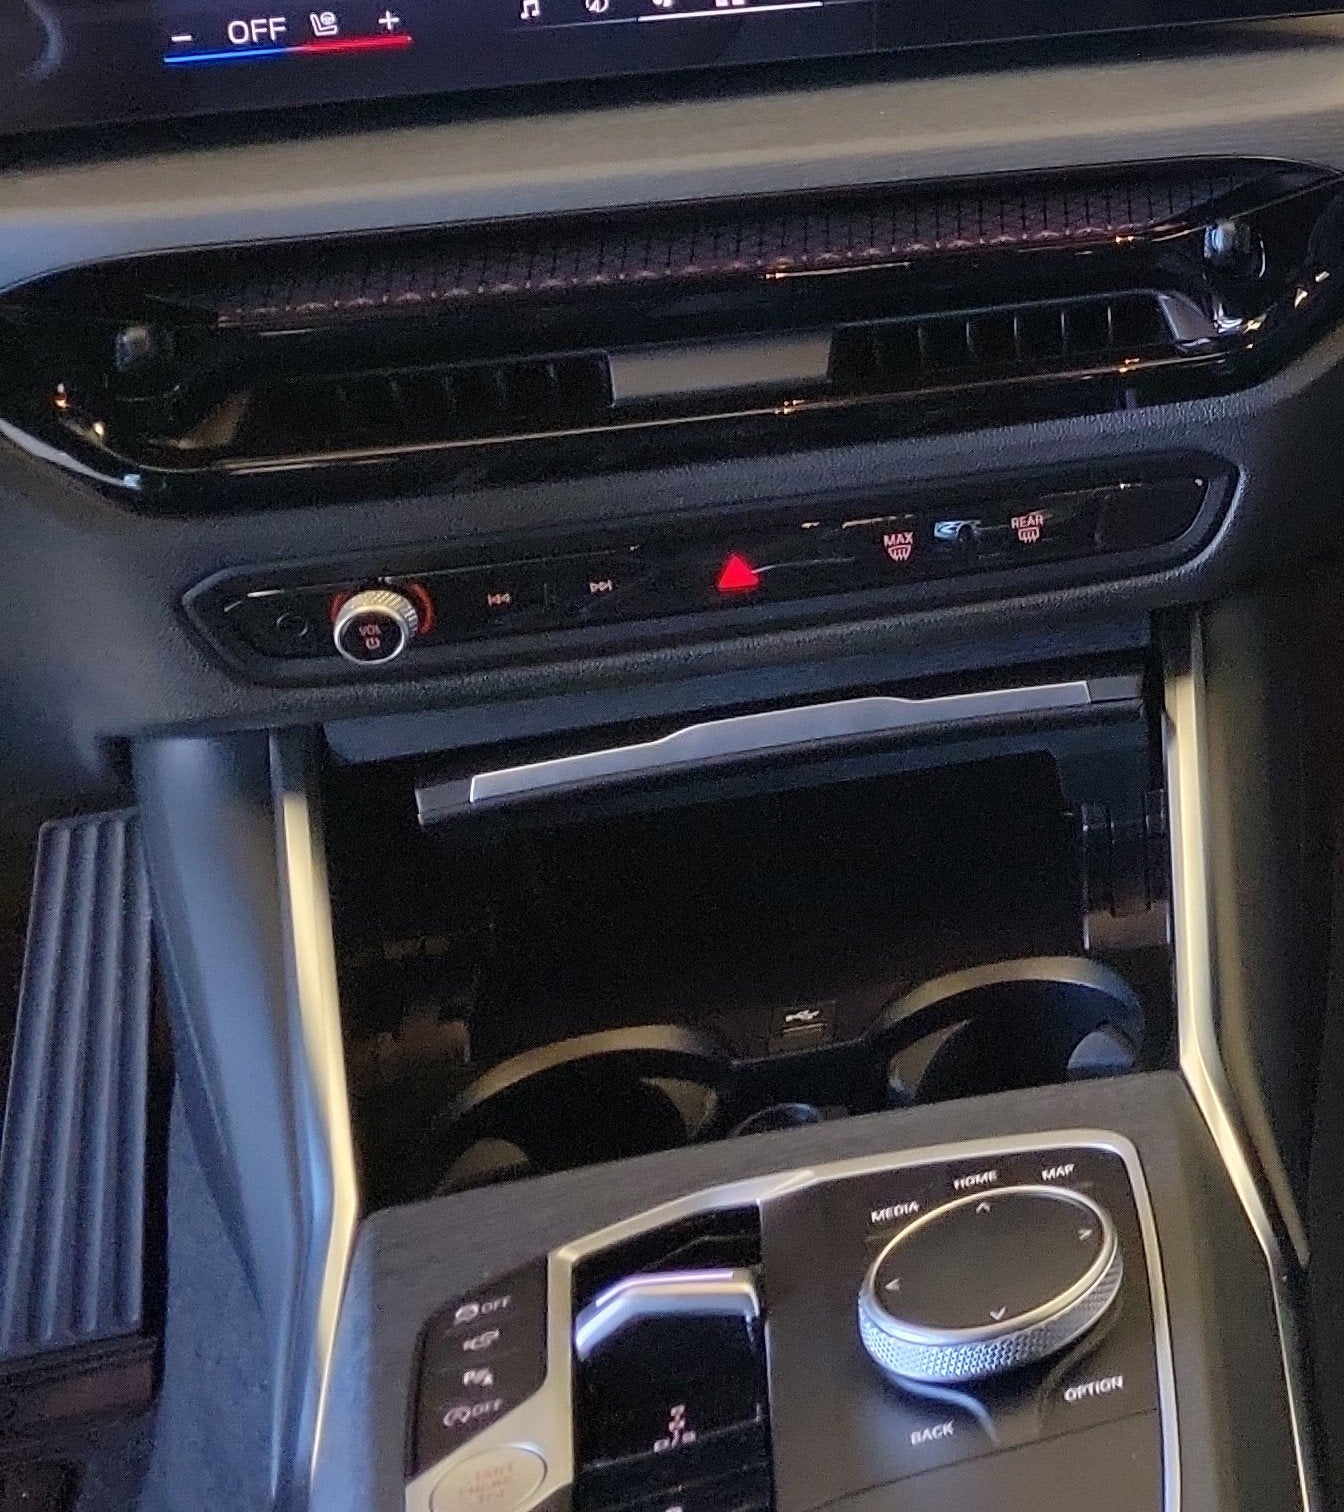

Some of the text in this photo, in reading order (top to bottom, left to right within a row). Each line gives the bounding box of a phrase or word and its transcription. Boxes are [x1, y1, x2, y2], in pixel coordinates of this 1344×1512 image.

[227, 16, 287, 44] OFF
[1010, 513, 1044, 530] REAR
[883, 531, 914, 547] MAX
[953, 1169, 998, 1190] HOME
[1041, 1163, 1075, 1181] MAP
[870, 1200, 920, 1223] MEDIA
[1063, 1375, 1124, 1402] OPTION
[910, 1420, 955, 1446] BACK
